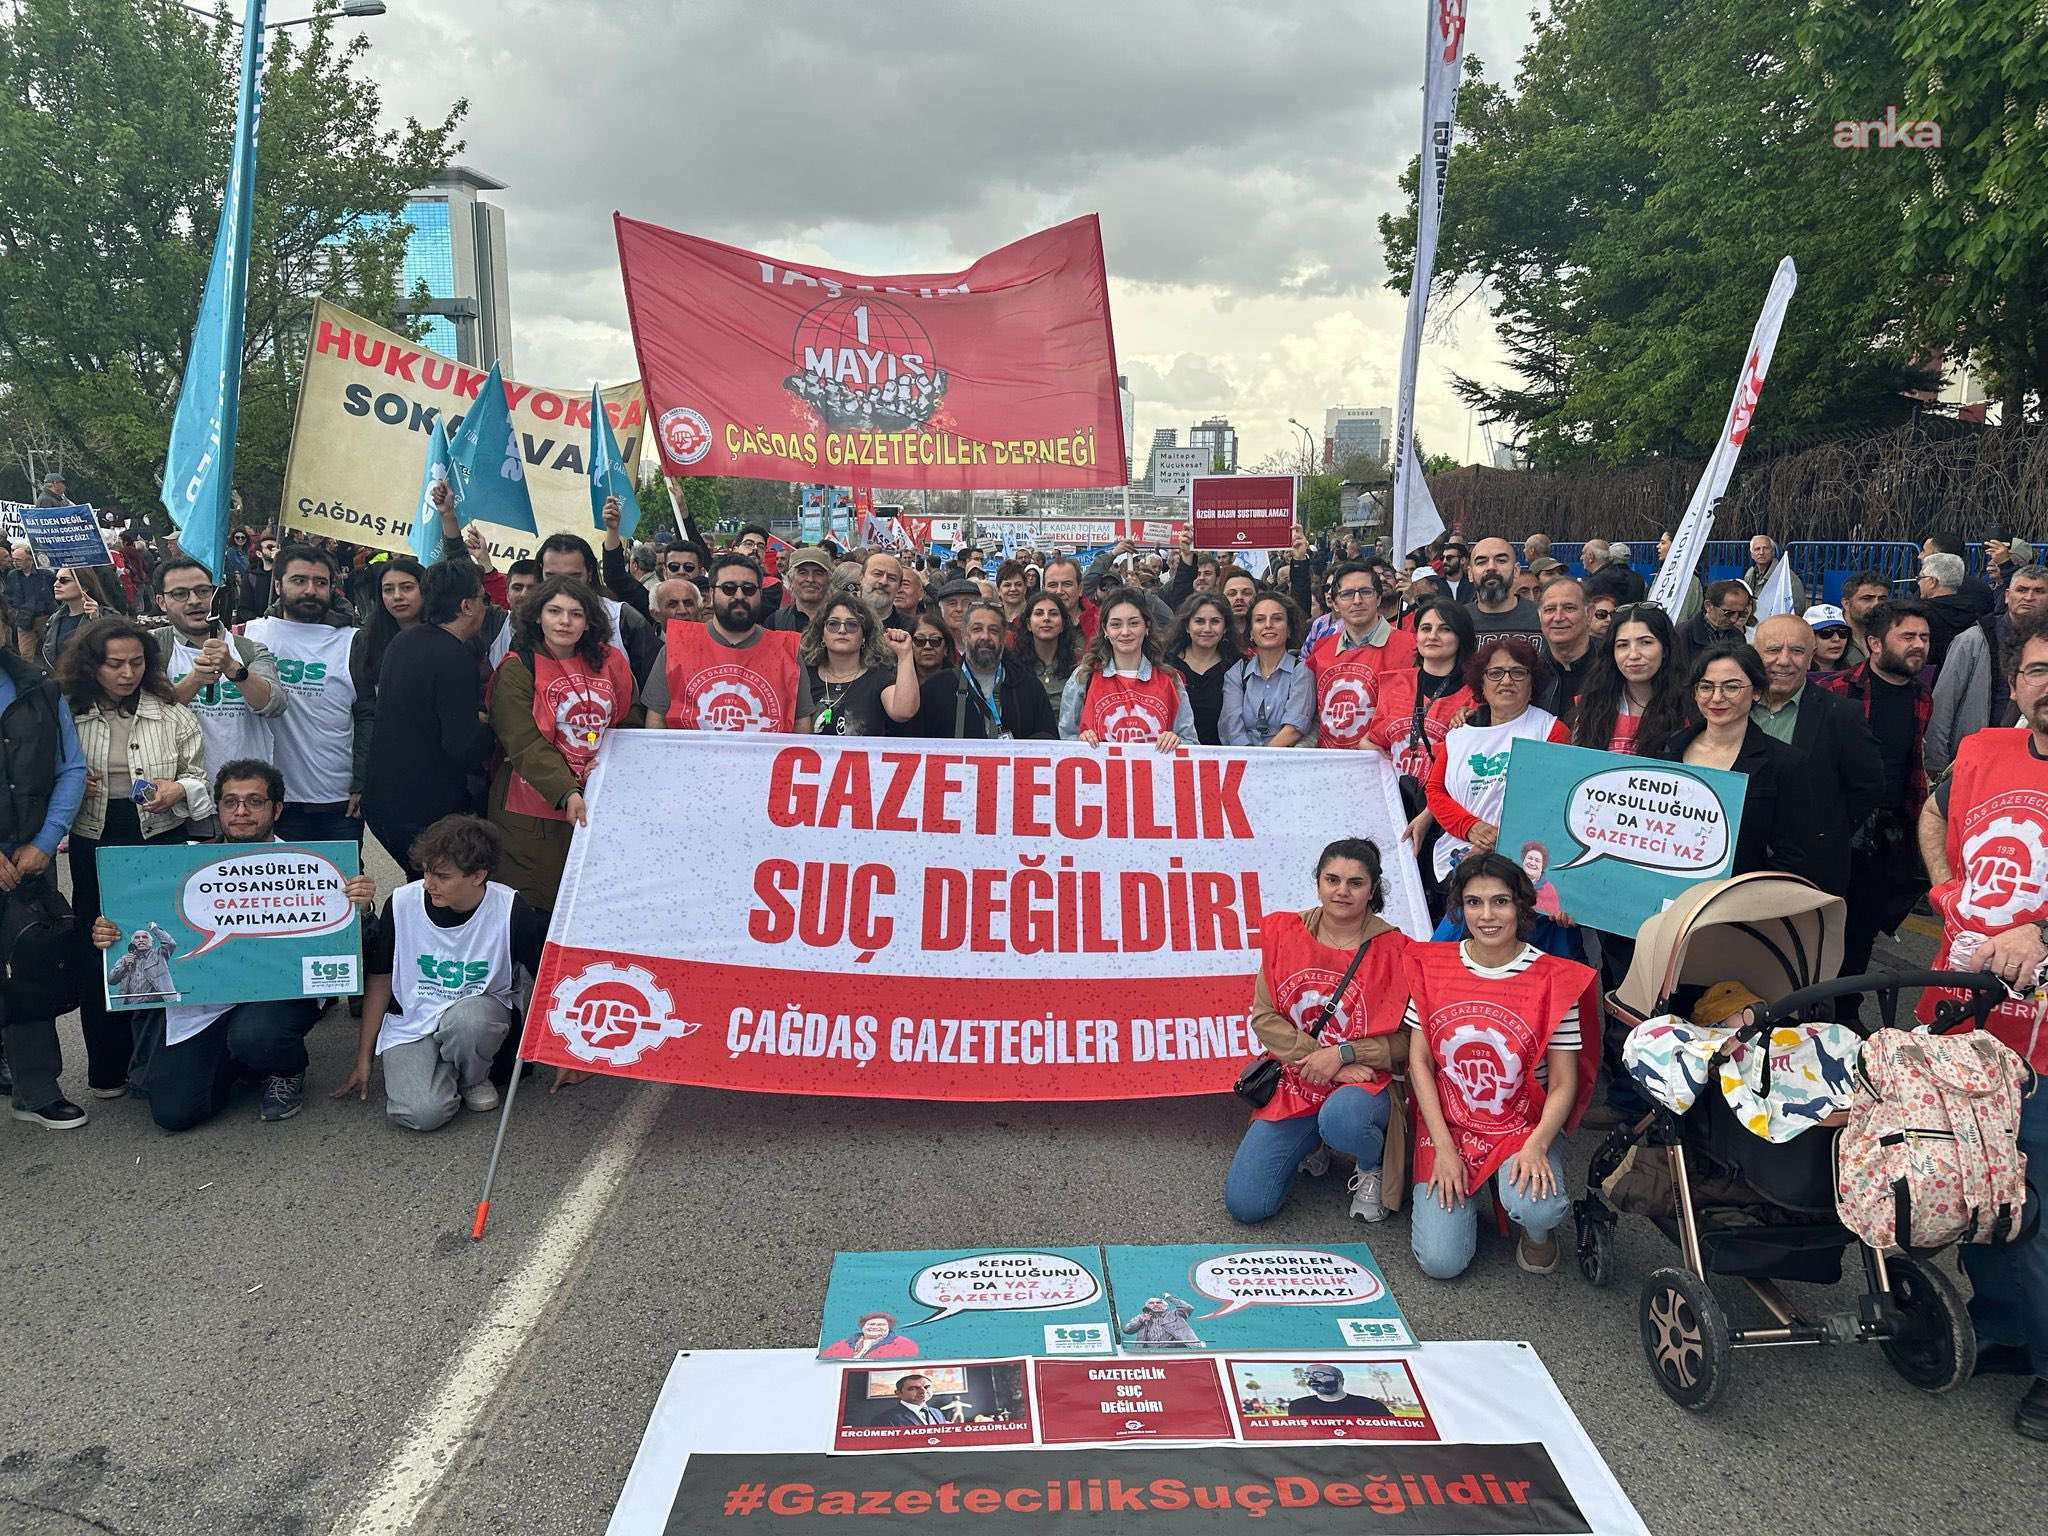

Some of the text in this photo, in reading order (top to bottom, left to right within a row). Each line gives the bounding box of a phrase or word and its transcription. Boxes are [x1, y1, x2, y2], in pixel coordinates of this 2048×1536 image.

[853, 304, 871, 345] 1
[316, 320, 487, 402] HUKUK
[804, 346, 924, 384] MAYIS
[725, 423, 818, 468] ÇAĞDAŞ
[826, 431, 988, 466] GAZETECİLER
[993, 426, 1097, 467] DERNEĞİ
[298, 497, 388, 535] ÇAĞDAŞ
[1196, 508, 1216, 519] ÖZGÜR
[767, 746, 1256, 841] GAZETECİLİK
[1628, 776, 1678, 796] KENDİ
[1586, 788, 1719, 823] YOKSULLUĞUNU
[1617, 813, 1676, 836] DA YAZ
[1586, 826, 1705, 861] GAZETECİ YAZ
[218, 863, 319, 876] SANSÜRLEN
[200, 879, 338, 893] OTOSANSÜRLEN
[214, 894, 325, 909] GAZETECİLİK
[748, 853, 1263, 965] SUÇ DEĞİLDİR!
[312, 961, 350, 980] tgs
[417, 955, 489, 988] tgs
[725, 1003, 877, 1070] ÇAĞDAŞ
[890, 1011, 1120, 1066] GAZETECİLER
[979, 1258, 1032, 1267] KENDİ
[1228, 1256, 1333, 1265] SANSÜRLEN
[932, 1268, 1080, 1279] YOKSULLUĞUNU
[1211, 1266, 1358, 1276] OTOSANSÜRLEN
[973, 1281, 1040, 1290] DA YAZ
[1228, 1277, 1349, 1286] GAZETECİLİK
[938, 1290, 1076, 1303] GAZETECİ YAZ
[1054, 1327, 1101, 1342] tgs
[1349, 1321, 1396, 1336] tgs
[1088, 1366, 1167, 1381] GAZETECİLİK
[1116, 1385, 1143, 1398] SUÇ
[841, 1427, 900, 1438] ERCÜMENT
[964, 1421, 1028, 1433] ÖZGÜRLÜK!
[1250, 1417, 1425, 1428] ALİ BARIŞ KURT'A ÖZGÜRLÜK!
[723, 1474, 1534, 1518] #GazetecilikSuçDeğildir
